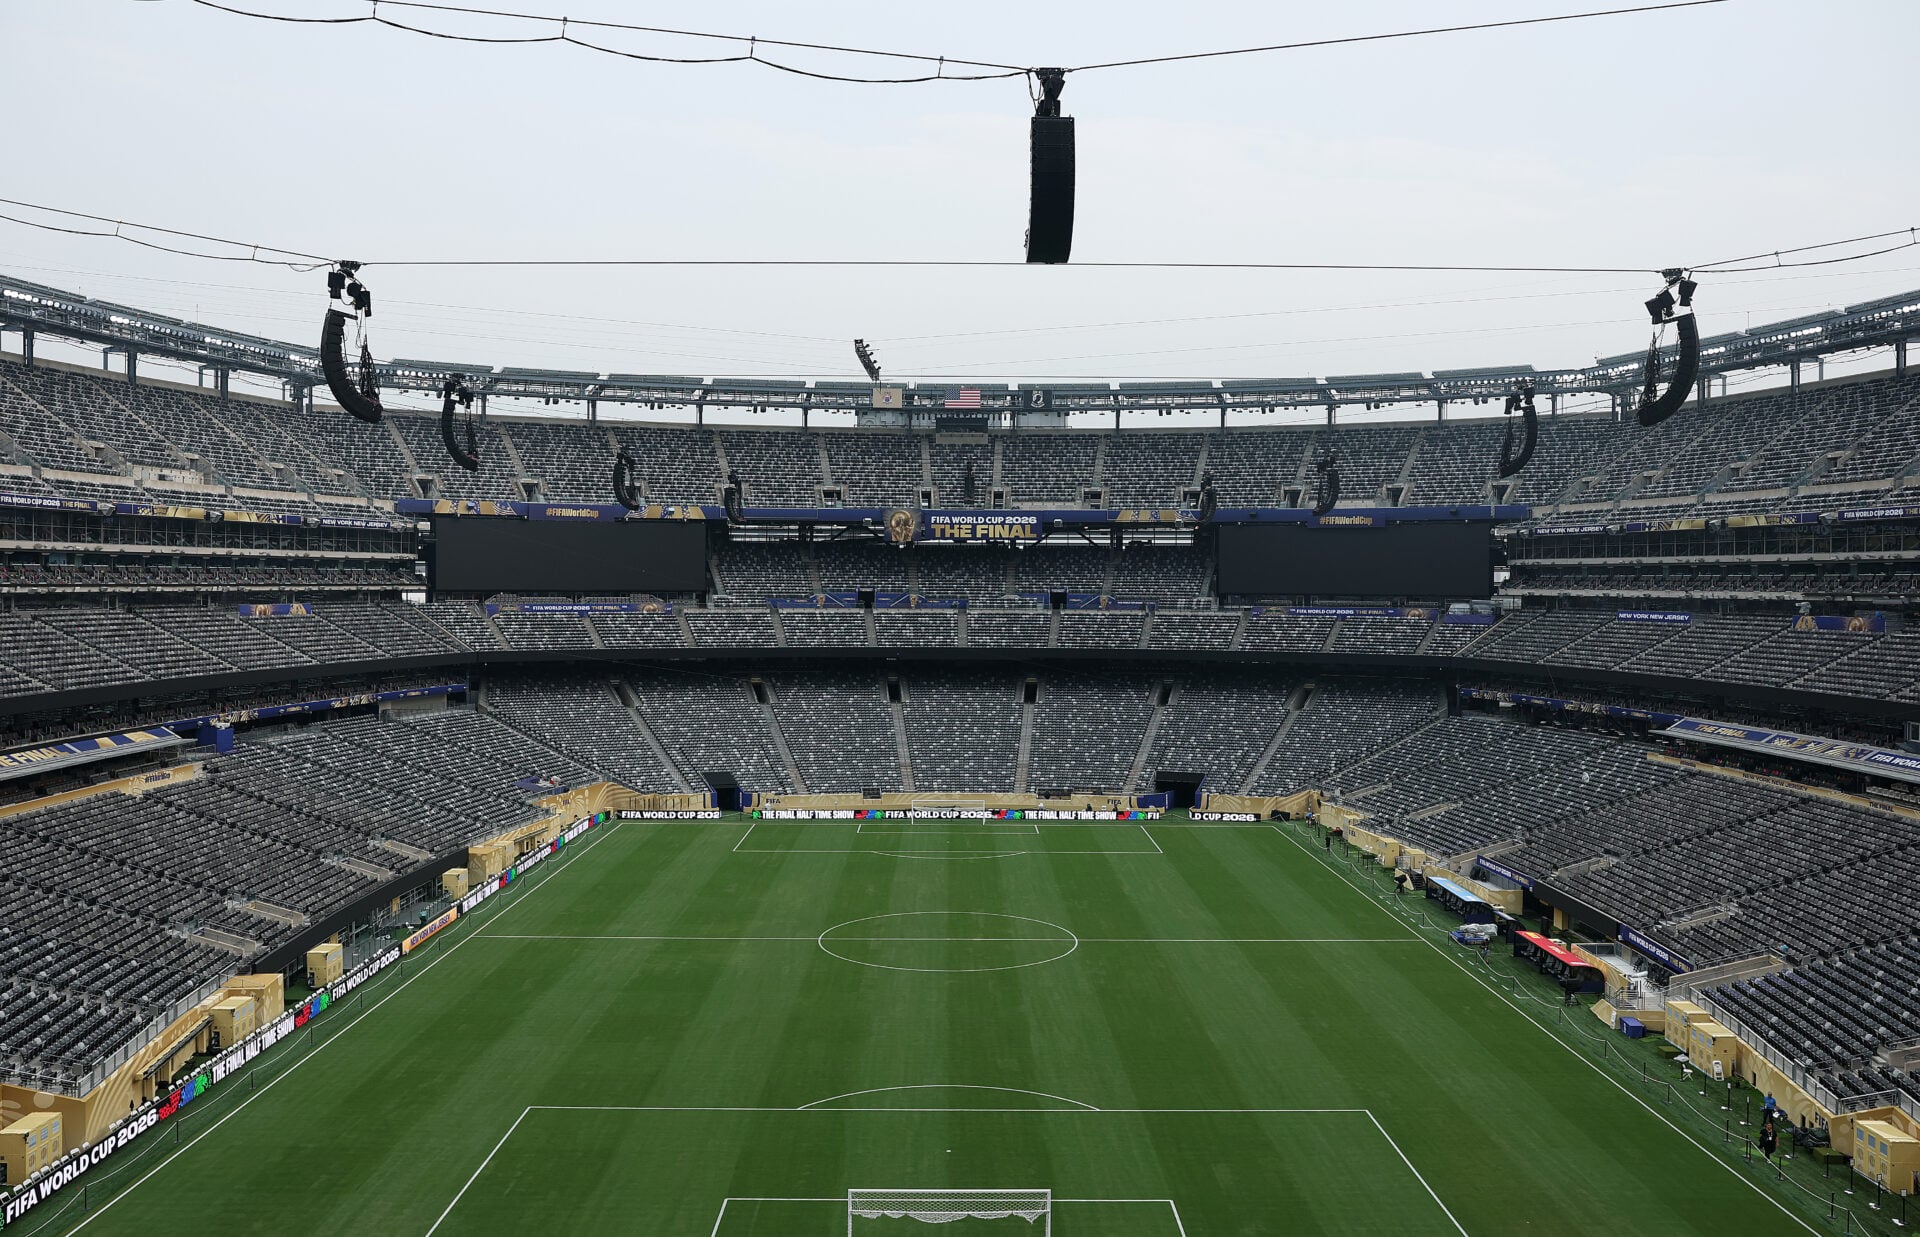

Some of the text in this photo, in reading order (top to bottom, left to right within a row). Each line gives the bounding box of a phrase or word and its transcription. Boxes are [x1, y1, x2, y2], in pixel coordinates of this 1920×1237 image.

[546, 508, 599, 519] #FIFAWorldCup
[952, 516, 983, 524] WORLD
[986, 516, 1004, 524] CUP
[1005, 516, 1037, 524] 2026
[1320, 516, 1372, 525] #FIFAWorldCup
[931, 524, 1037, 538] THE FINAL
[1695, 724, 1748, 738] THE FINAL
[10, 747, 69, 764] FINAL
[1871, 754, 1894, 763] FIFA
[621, 811, 640, 819] FIFA
[643, 811, 676, 819] WORLD
[677, 811, 696, 819] CUP
[762, 810, 855, 819] THE FINAL HALF TIME SHOW
[1025, 811, 1117, 820] THE FINAL HALF TIME SHOW
[332, 947, 400, 1001] FIFA WORLD CUP 2026
[212, 1014, 295, 1084] THE FINAL HALF TIME SHOW
[6, 1108, 157, 1224] FIFA WORLD CUP 2026
